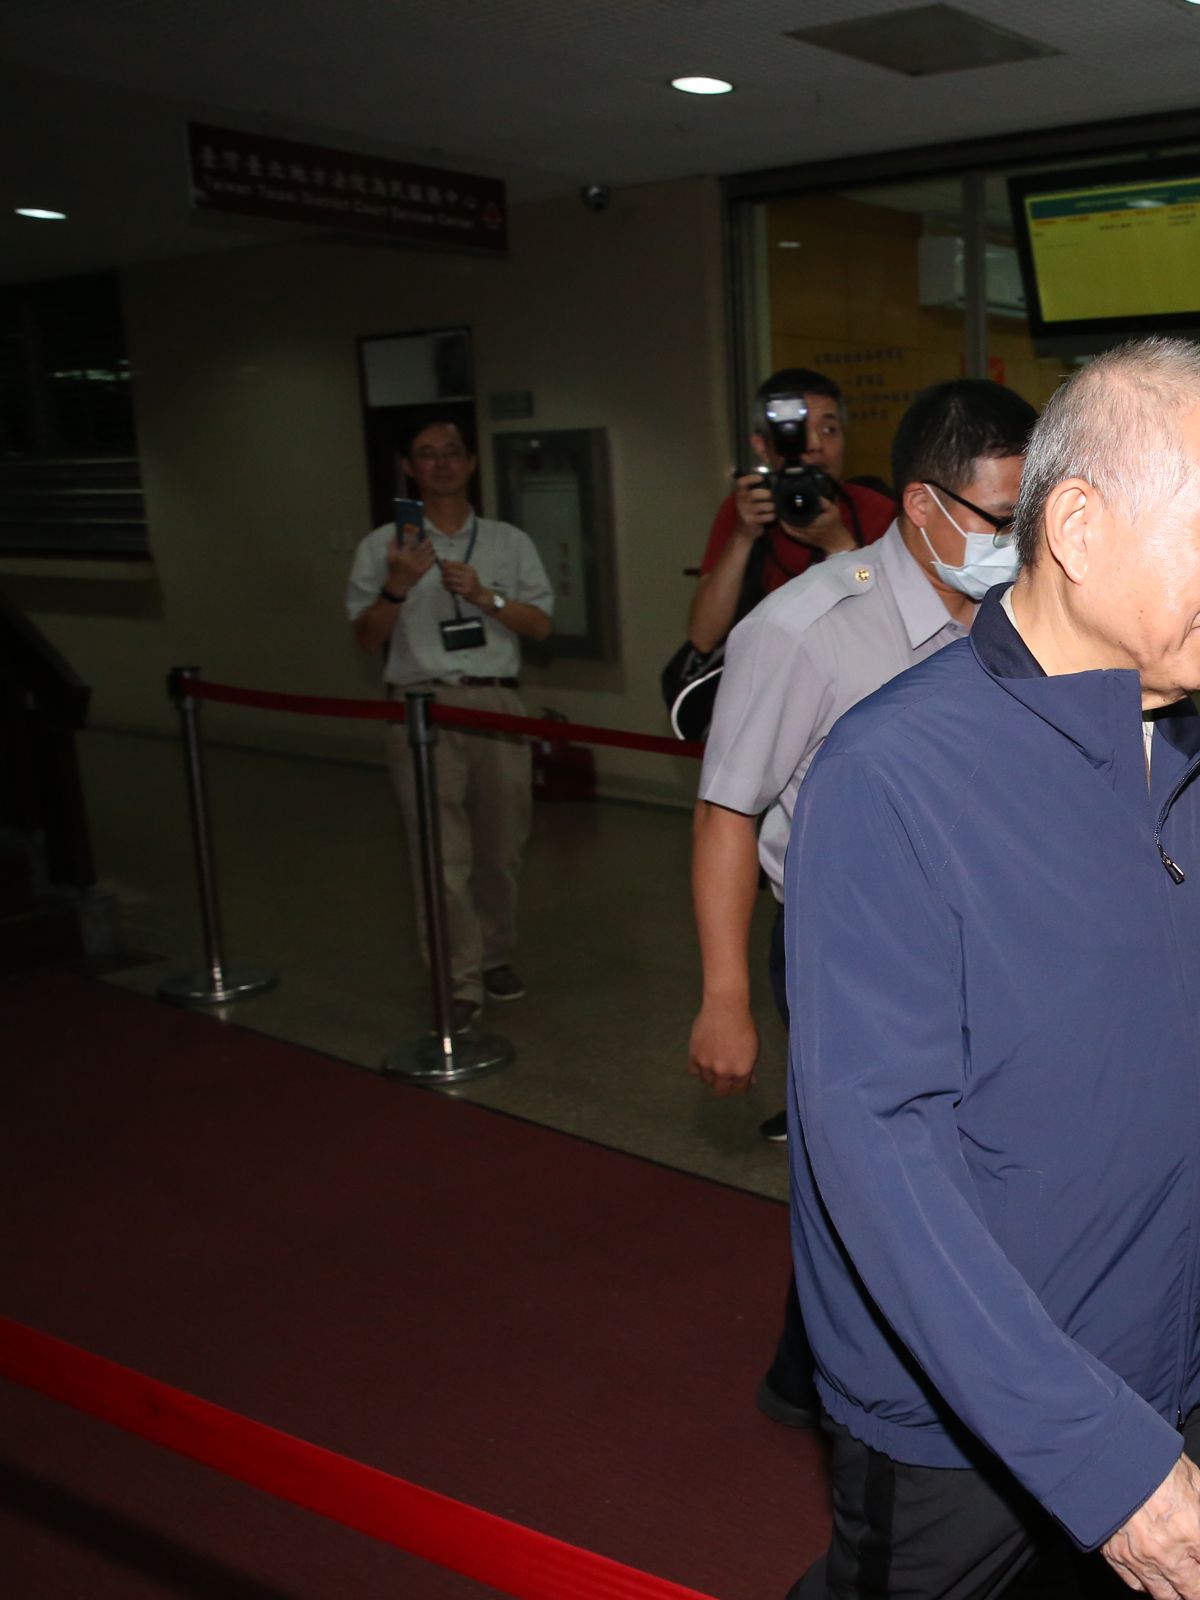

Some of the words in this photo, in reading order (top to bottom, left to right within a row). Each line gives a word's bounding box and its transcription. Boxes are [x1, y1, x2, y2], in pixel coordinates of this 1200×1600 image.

[203, 174, 253, 196] Taiwan
[257, 184, 297, 204] Taipei
[301, 192, 350, 211] District
[354, 200, 388, 217] Court
[391, 206, 434, 225] Service
[438, 213, 476, 230] Center
